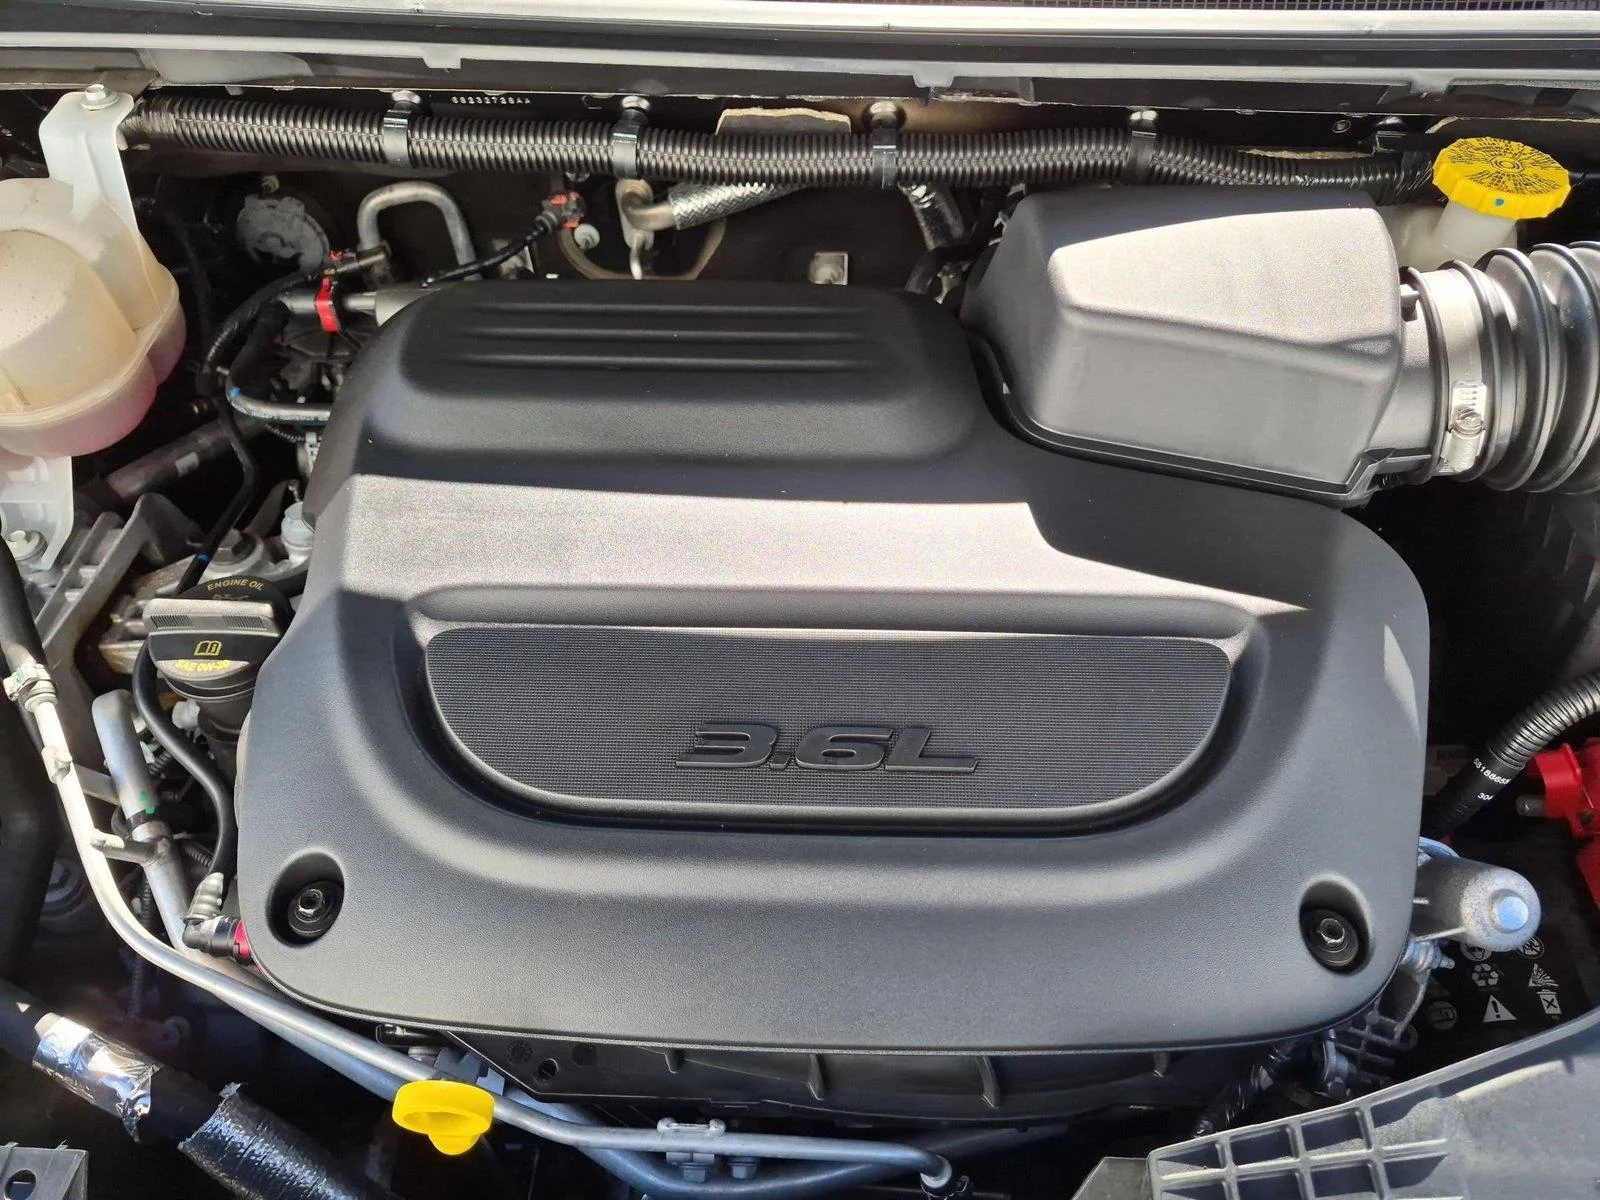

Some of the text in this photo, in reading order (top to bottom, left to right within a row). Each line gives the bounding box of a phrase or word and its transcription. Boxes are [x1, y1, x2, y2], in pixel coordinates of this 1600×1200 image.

[207, 579, 265, 592] ENGINE OIL
[175, 660, 230, 672] SAE 0W-20
[675, 723, 978, 774] 3.6L
